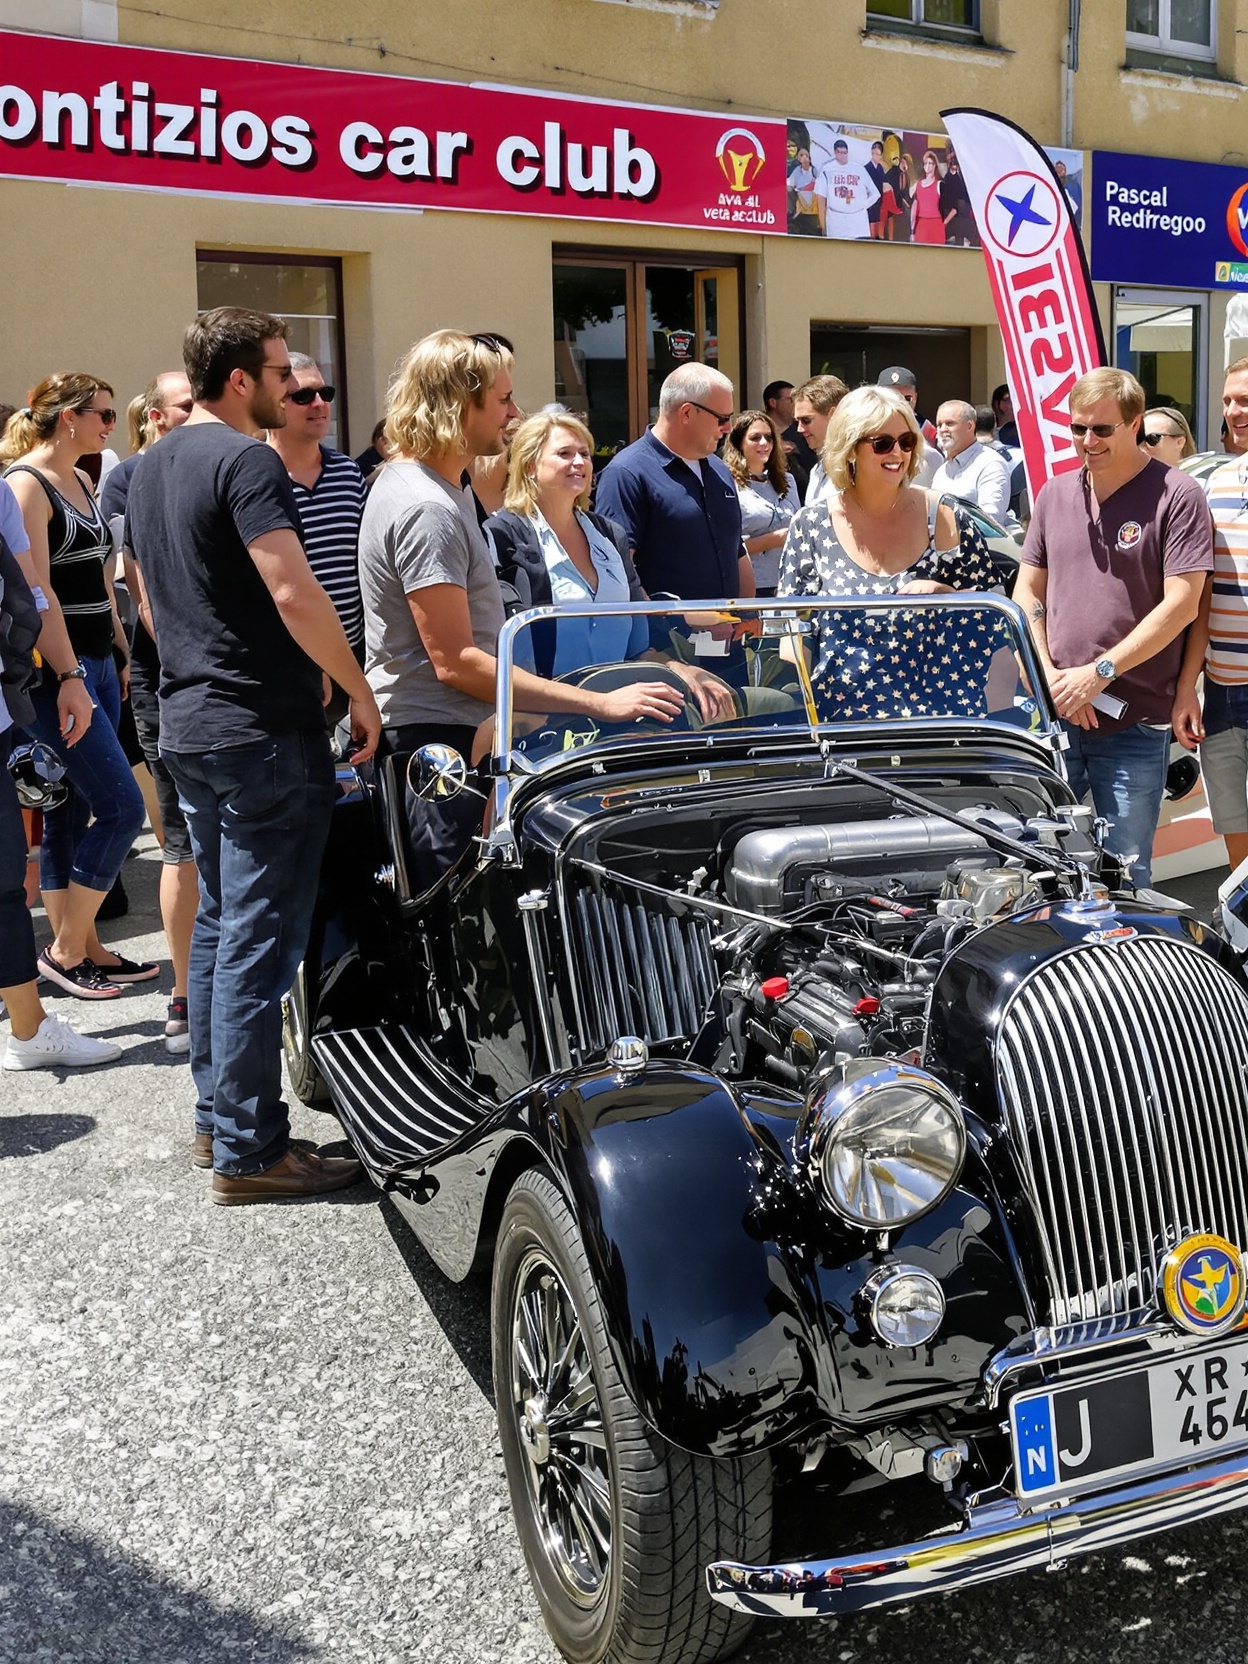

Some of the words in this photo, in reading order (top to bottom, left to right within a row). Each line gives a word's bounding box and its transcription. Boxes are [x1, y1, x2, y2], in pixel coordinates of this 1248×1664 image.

[0, 82, 313, 166] ontizios
[340, 121, 468, 178] car
[496, 121, 657, 197] club
[1106, 181, 1167, 207] Pascal
[1174, 1356, 1229, 1401] XR
[1059, 1398, 1092, 1467] J
[1027, 1445, 1046, 1475] N
